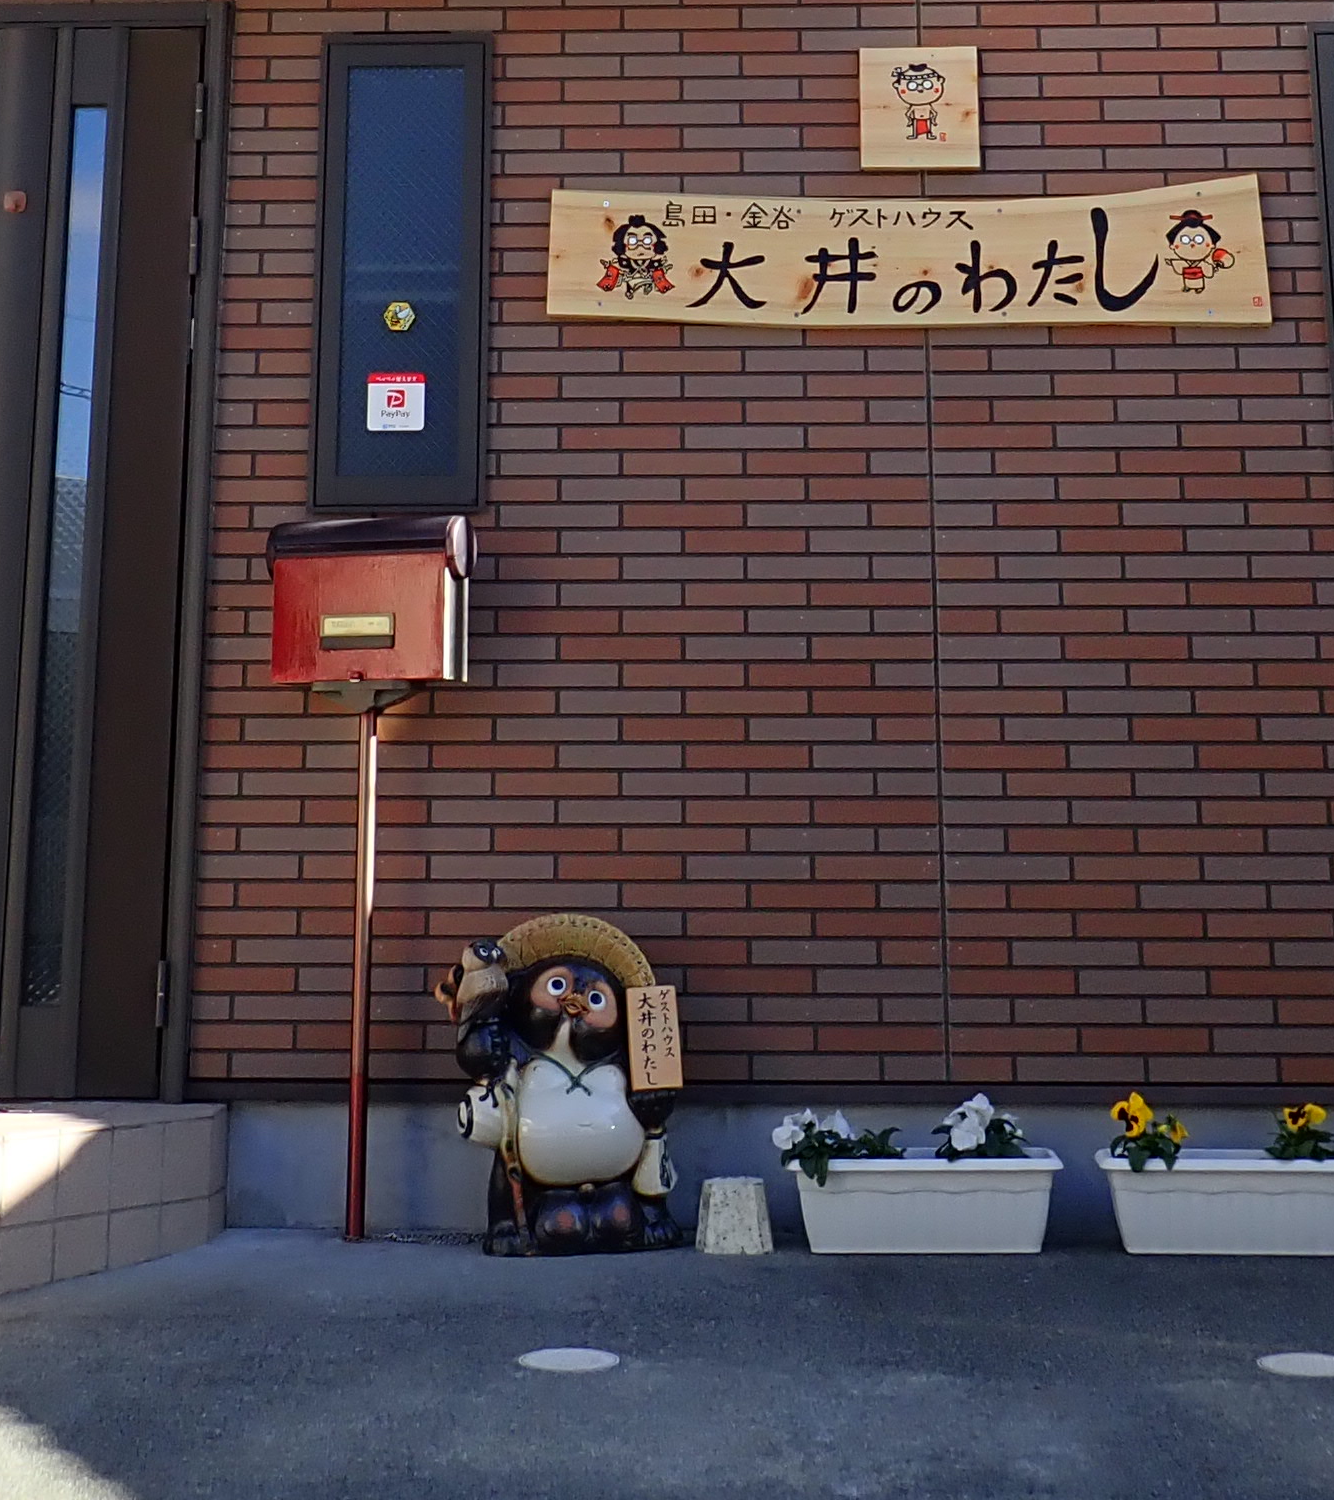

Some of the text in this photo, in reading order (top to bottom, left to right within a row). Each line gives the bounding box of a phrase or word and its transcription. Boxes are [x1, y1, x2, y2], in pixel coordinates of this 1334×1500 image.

[828, 206, 974, 231] ゲストハウス
[685, 206, 1159, 315] 大井のわたし
[380, 409, 411, 419] PayPay
[637, 992, 658, 1086] 大井のわたし
[659, 989, 675, 1058] ゲストハウス
